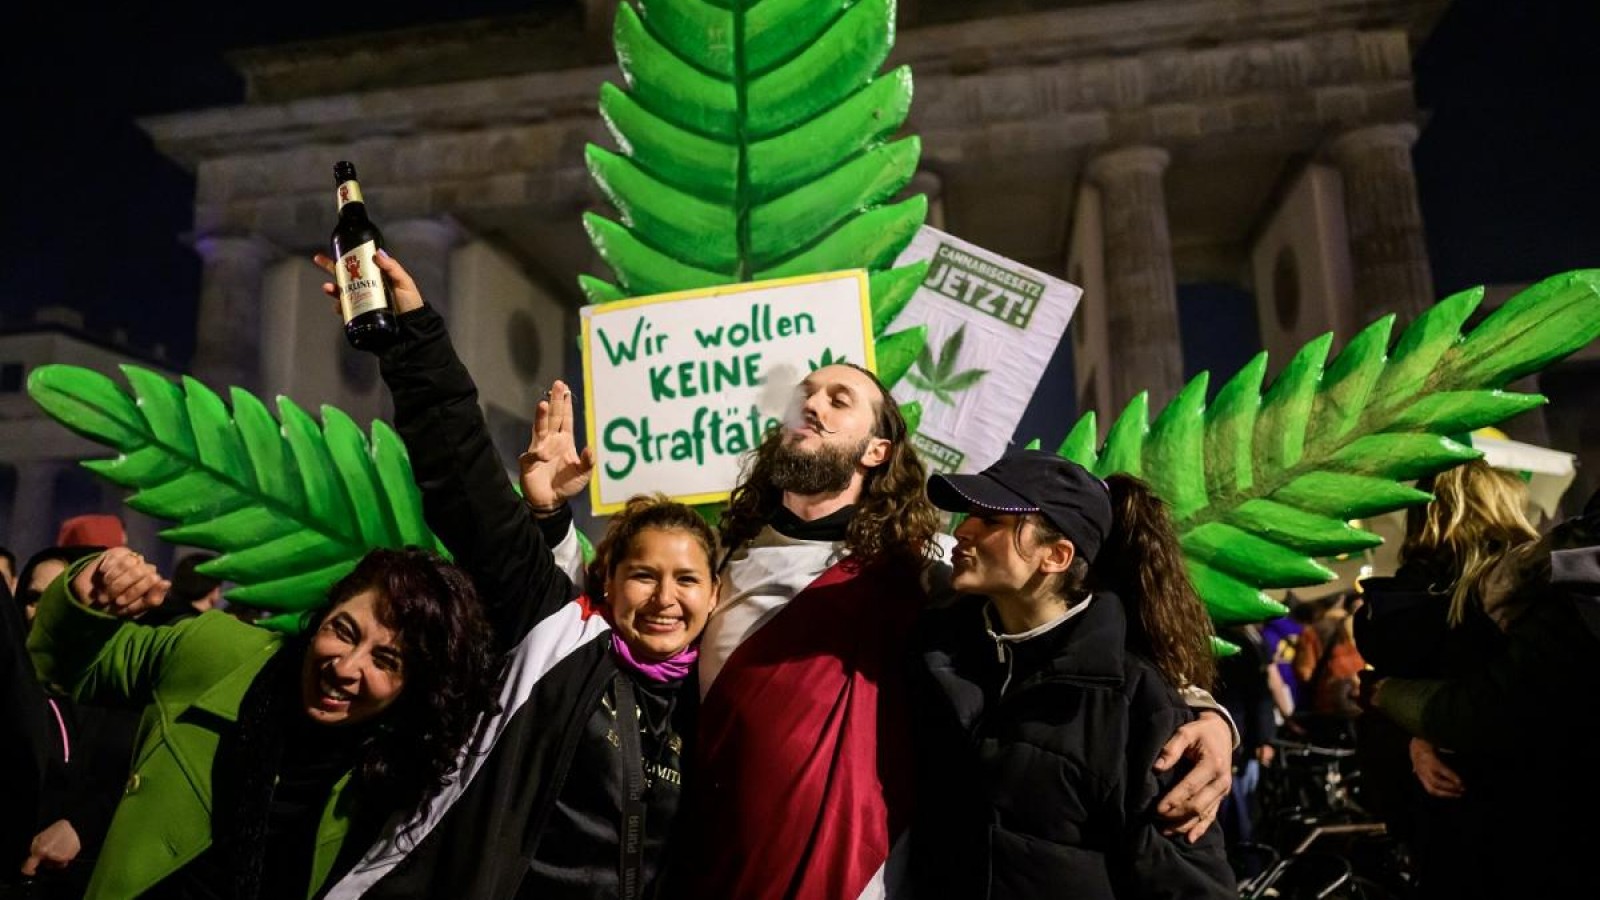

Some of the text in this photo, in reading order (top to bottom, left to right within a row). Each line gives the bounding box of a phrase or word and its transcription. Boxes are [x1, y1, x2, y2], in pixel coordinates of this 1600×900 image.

[924, 263, 1032, 325] JETZT!
[938, 246, 1043, 295] CANNABISGESETZ
[597, 303, 816, 367] Wir wollen
[649, 353, 763, 402] KEINE
[603, 404, 781, 481] Straftäte
